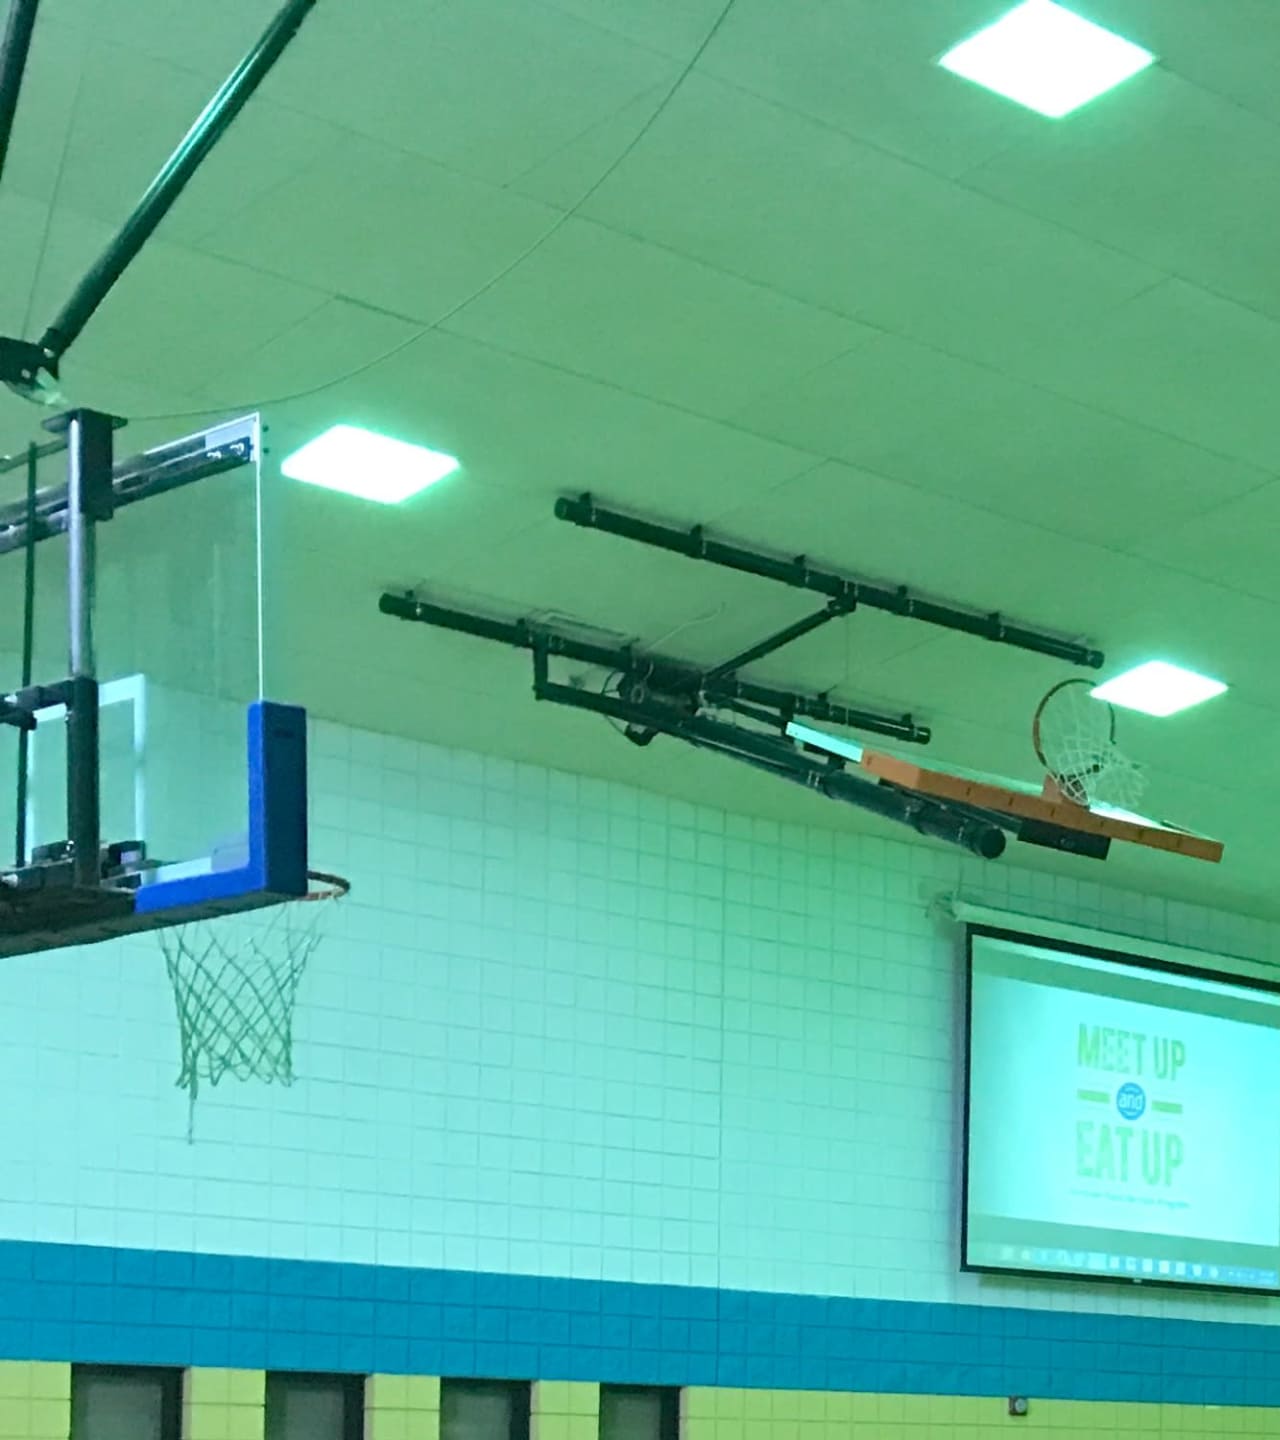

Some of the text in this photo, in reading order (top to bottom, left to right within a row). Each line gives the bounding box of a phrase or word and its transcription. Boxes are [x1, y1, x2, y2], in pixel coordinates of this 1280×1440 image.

[1078, 1022, 1186, 1081] MEET UP
[1119, 1092, 1143, 1109] and
[1076, 1120, 1184, 1187] EAT UP
